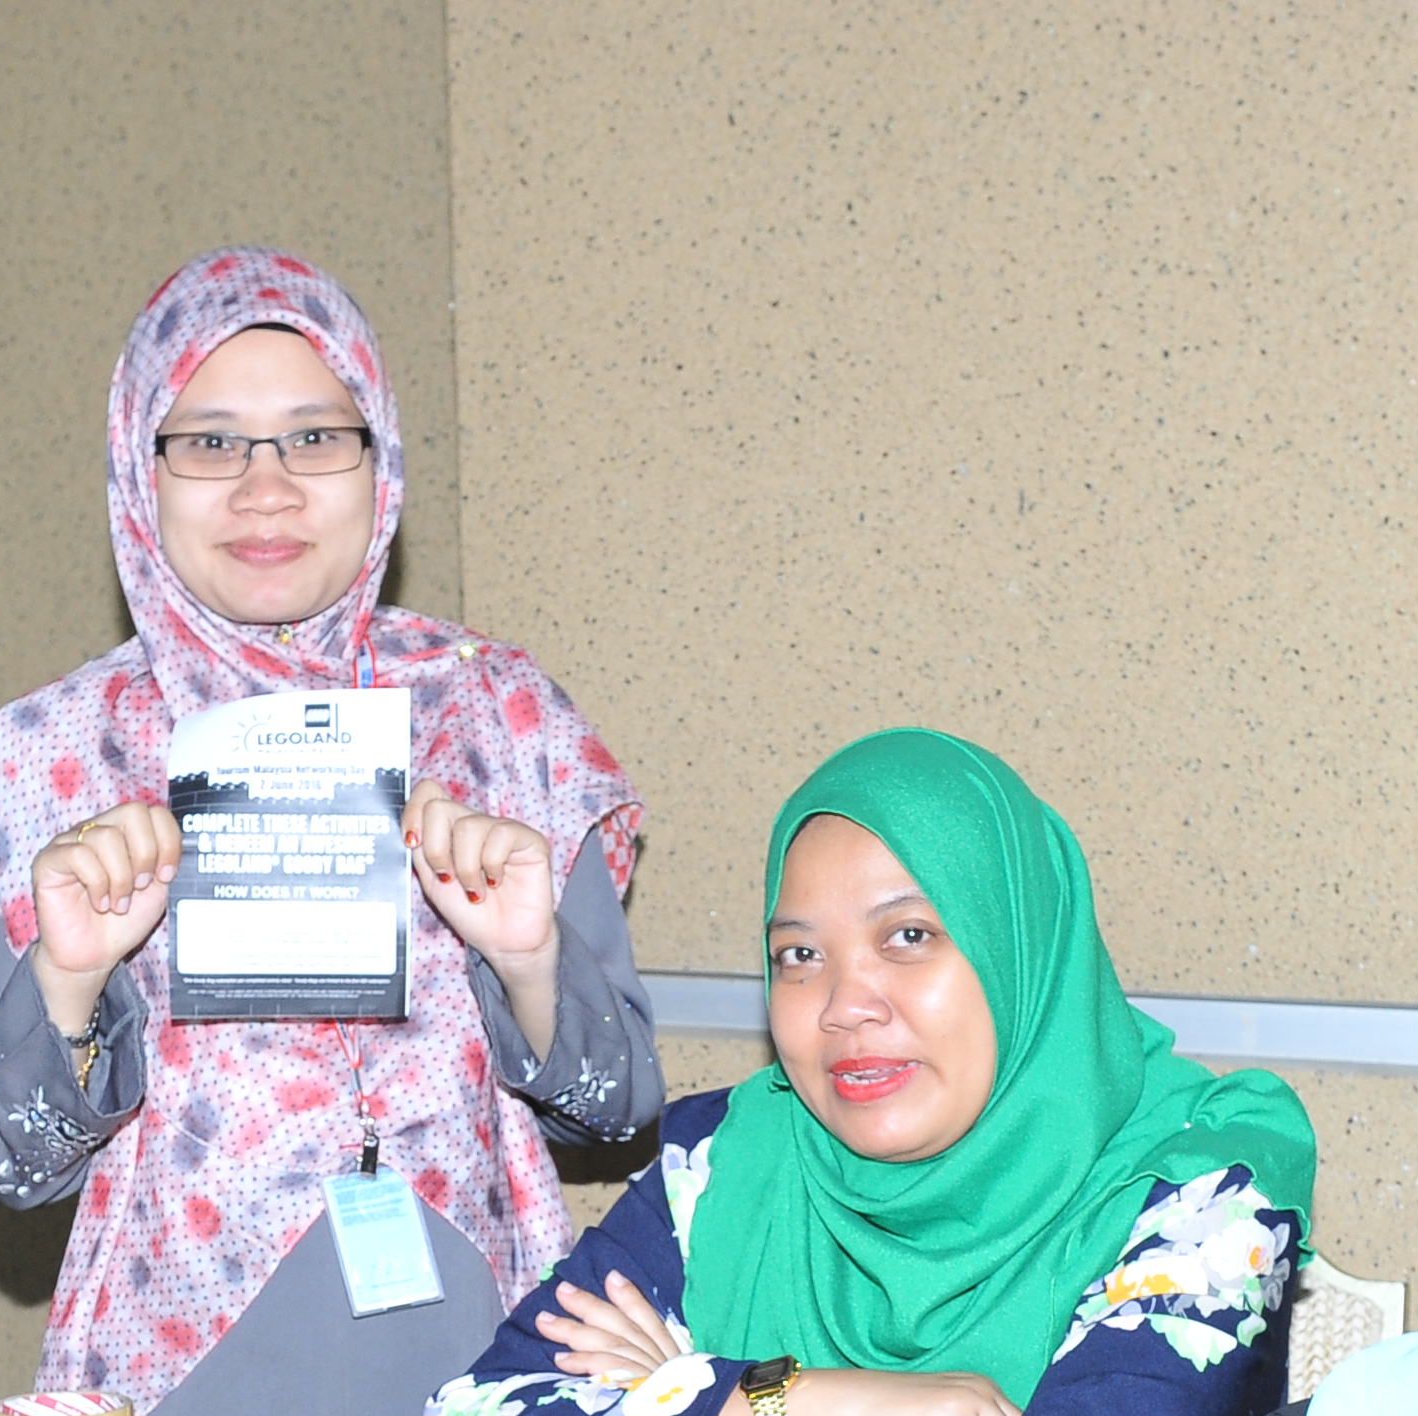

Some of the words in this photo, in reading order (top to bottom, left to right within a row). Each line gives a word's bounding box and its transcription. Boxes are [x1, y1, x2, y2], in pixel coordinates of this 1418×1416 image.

[182, 813, 260, 833] COMPLETE
[262, 814, 308, 833] THESE
[310, 814, 390, 834] ACTIVITIES
[198, 833, 212, 853] &
[214, 885, 249, 898] HOW
[251, 886, 290, 898] DOES
[293, 886, 307, 898] IT
[309, 886, 360, 899] WORK?
